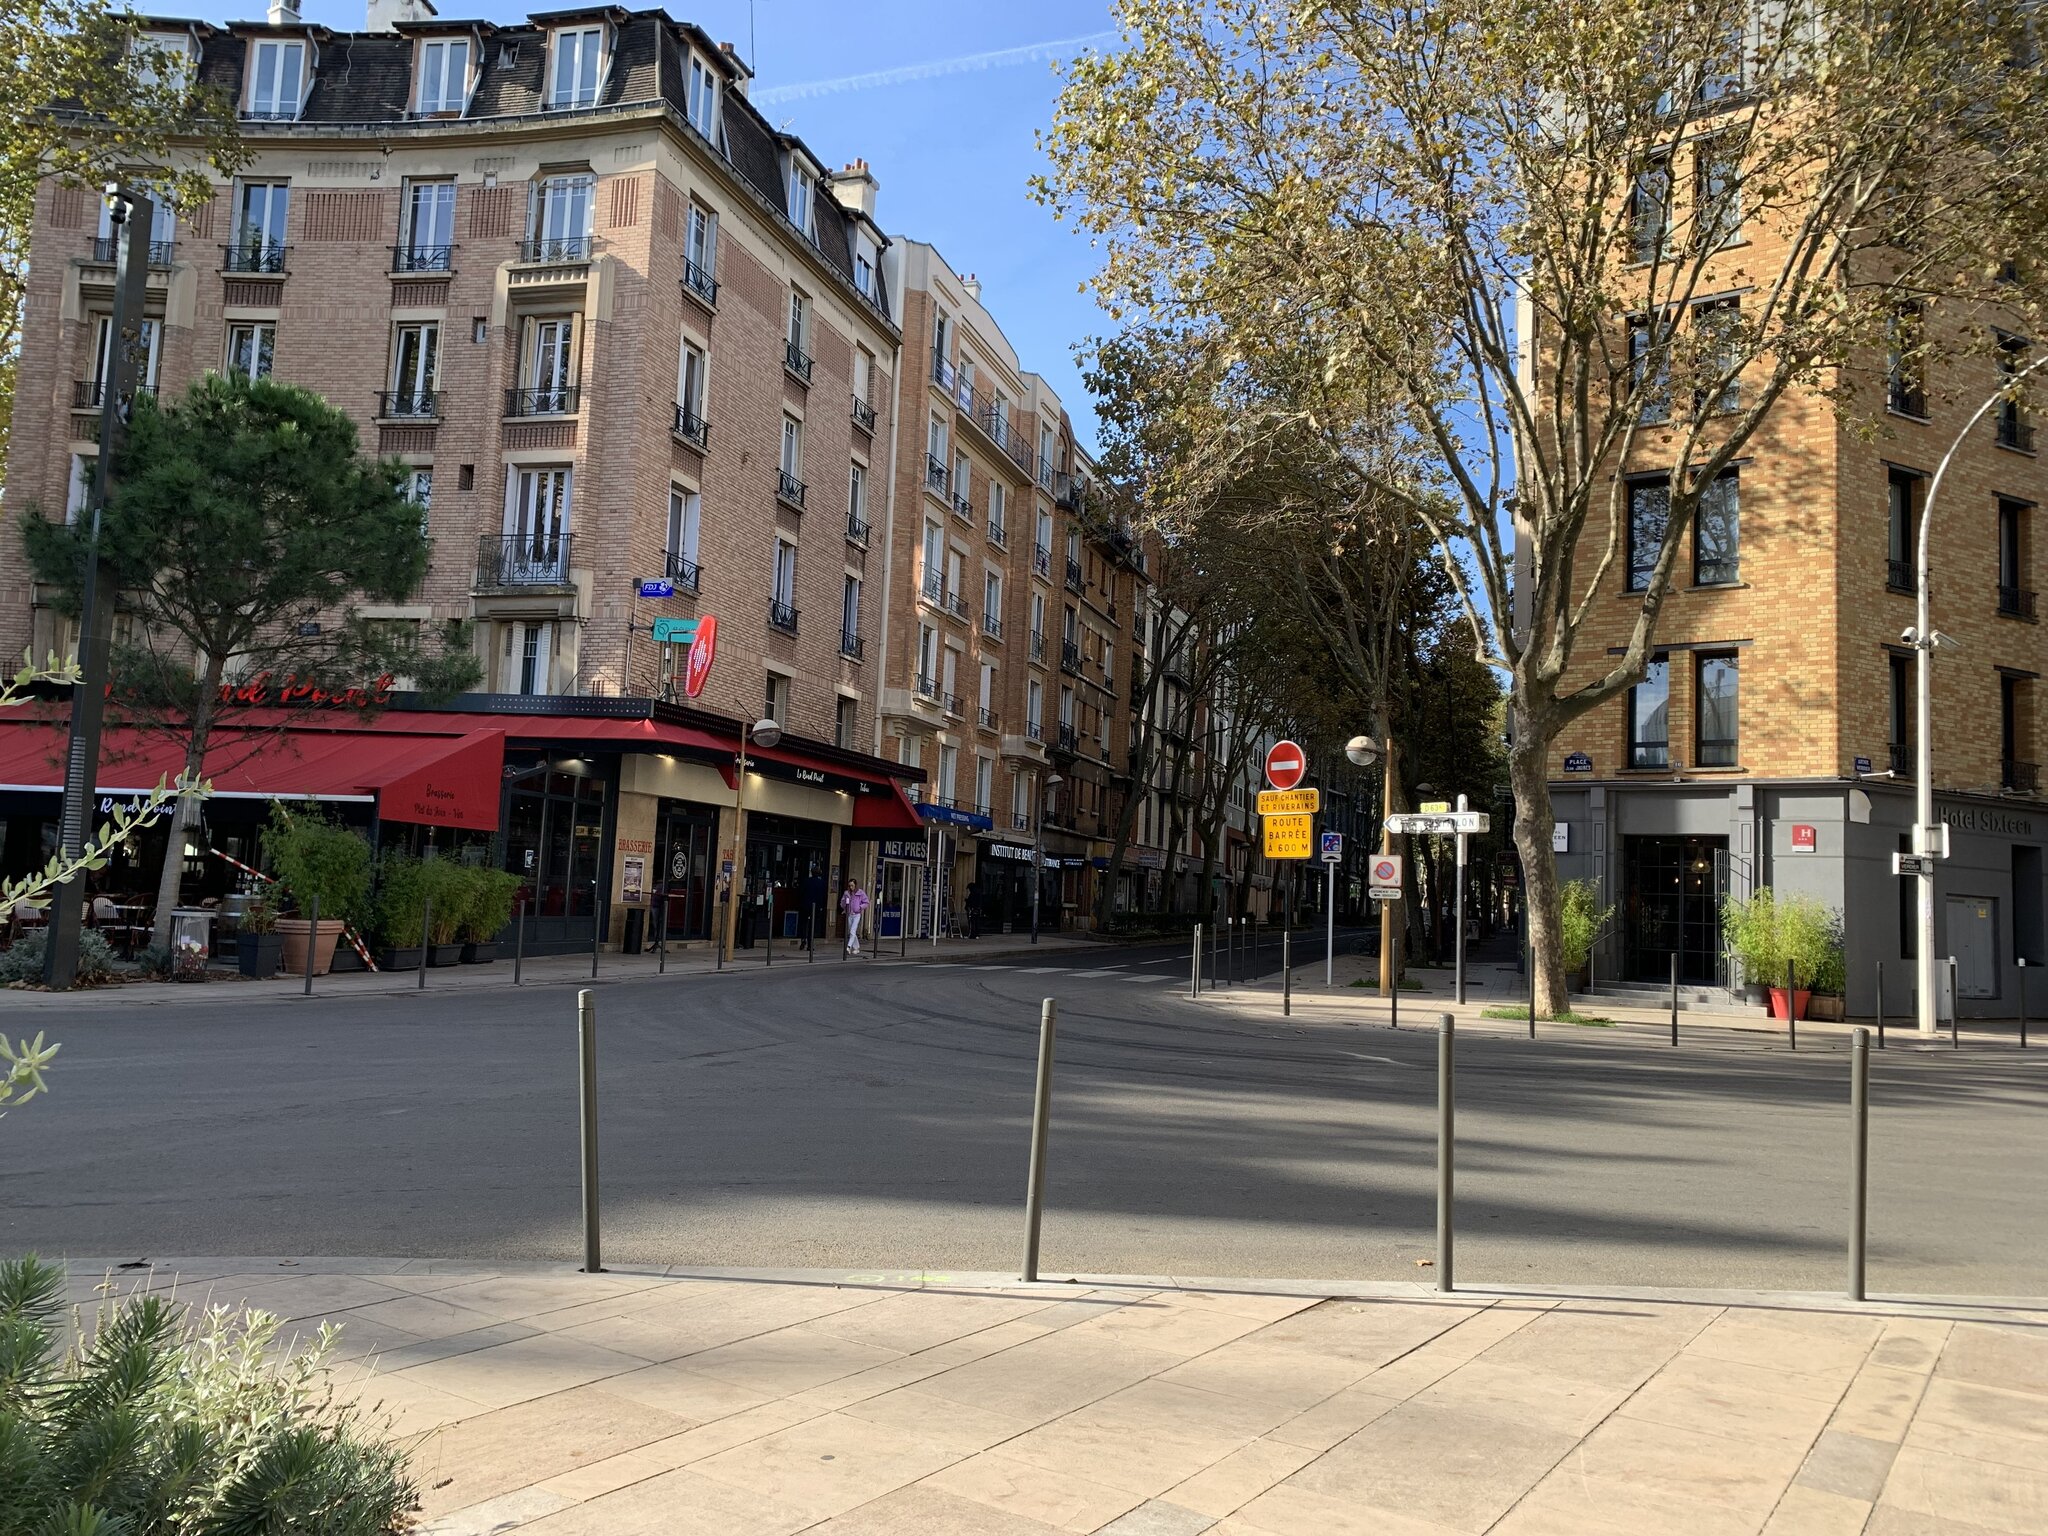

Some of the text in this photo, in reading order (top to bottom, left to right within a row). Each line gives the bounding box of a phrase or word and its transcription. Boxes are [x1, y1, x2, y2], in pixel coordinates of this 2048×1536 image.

[426, 783, 455, 800] Brasserie
[1261, 793, 1315, 803] SAUF CHANTIER
[1261, 802, 1315, 812] ET RIVERAINS
[1272, 818, 1303, 827] ROUTE
[1939, 806, 2032, 835] Hotel Sixteen
[1269, 829, 1307, 840] BARRÉE
[1801, 828, 1811, 838] H
[618, 838, 653, 854] BRASSERIE
[885, 840, 902, 856] NET
[991, 843, 1014, 859] INSTITUT
[1014, 847, 1022, 860] DE
[1278, 843, 1297, 852] 600
[1302, 843, 1309, 852] M
